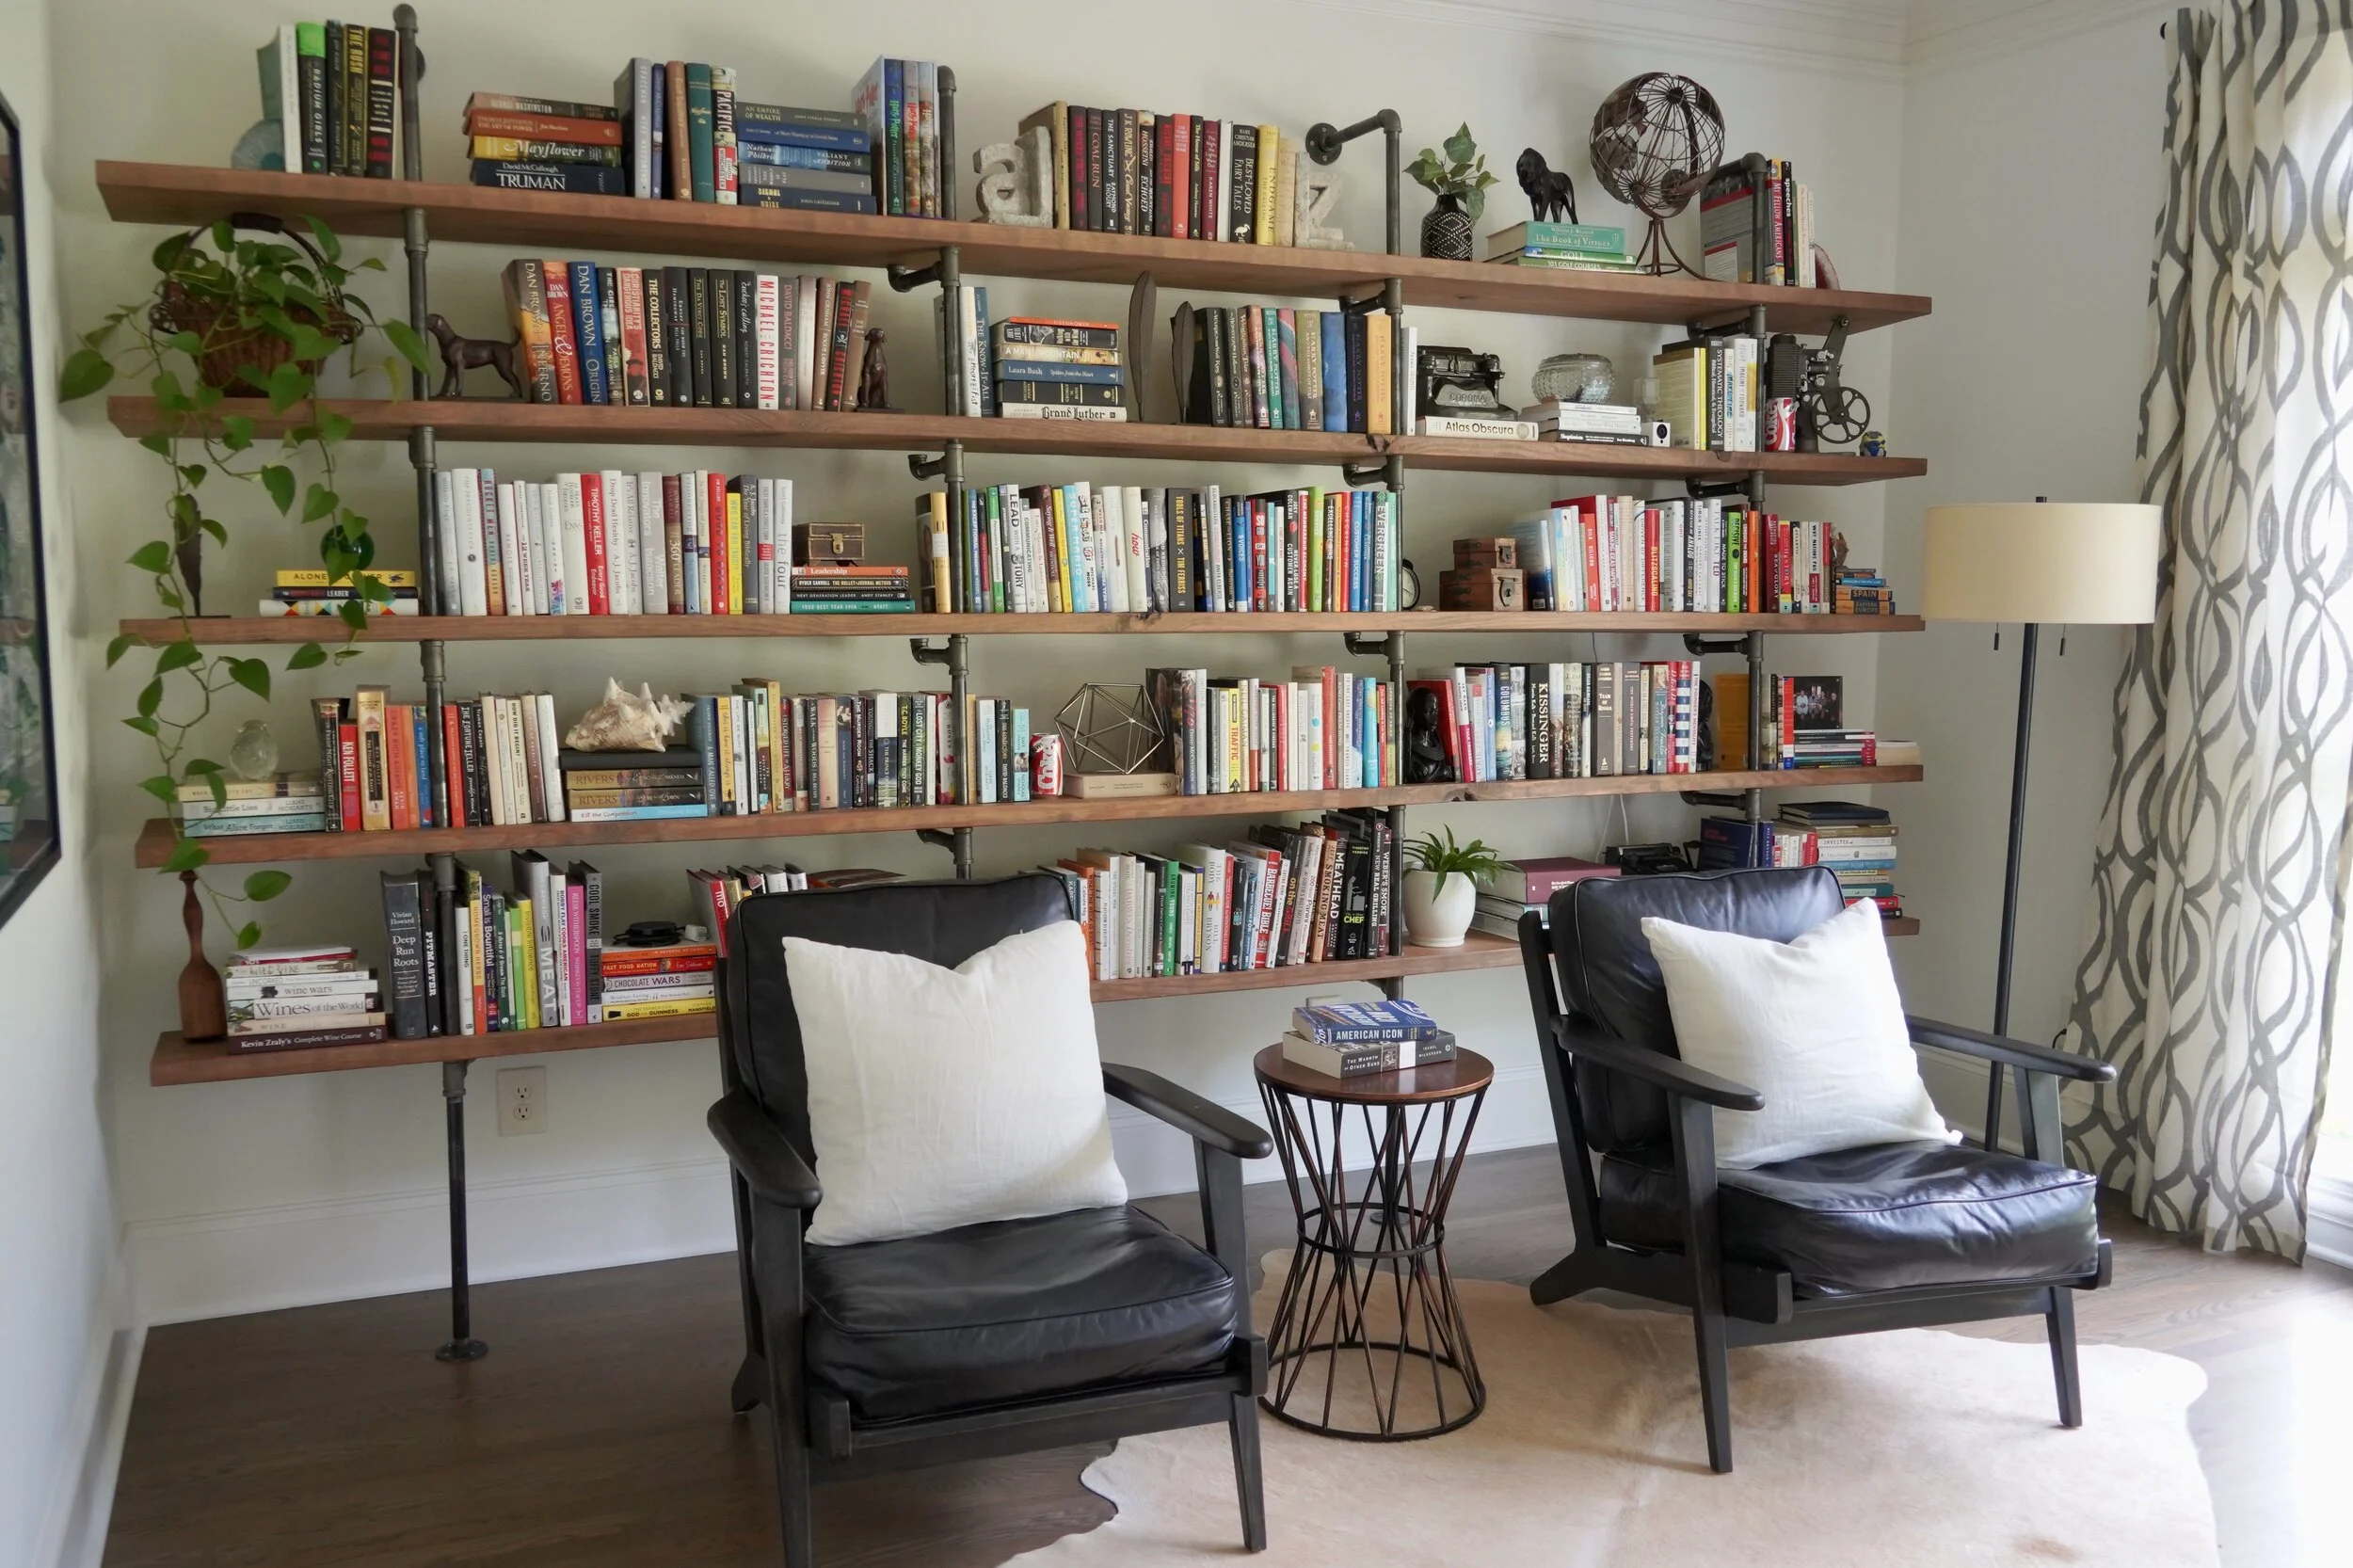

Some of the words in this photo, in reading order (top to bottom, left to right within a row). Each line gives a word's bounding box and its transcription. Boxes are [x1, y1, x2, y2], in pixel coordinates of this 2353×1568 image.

[313, 68, 324, 109] RADIUM
[716, 90, 733, 133] PACIFIC
[314, 112, 324, 143] GIRLS
[504, 140, 585, 159] Mayflower
[1092, 133, 1100, 162] COAL
[1107, 135, 1115, 178] SANCTUARY
[496, 173, 566, 191] TRUMAN
[1234, 159, 1243, 181] FAIRY
[1140, 175, 1148, 213] ECHOED
[1233, 184, 1242, 211] TALES
[1267, 167, 1277, 232] ENDGAME
[1784, 178, 1792, 217] speeches
[1773, 196, 1783, 222] FELLOW
[1535, 233, 1550, 242] The
[1552, 234, 1571, 243] Book
[1573, 236, 1581, 246] of
[1582, 237, 1610, 247] Virtues
[1774, 222, 1785, 259] AMERICANS
[577, 264, 591, 294] DAN
[1575, 263, 1601, 271] COURSES
[648, 279, 659, 296] THE
[784, 284, 793, 312] DAVID
[760, 280, 776, 332] MICHAEL
[580, 298, 596, 346] BROWN
[649, 296, 662, 349] COLLECTORS
[784, 312, 793, 350] BALDACCI
[977, 318, 985, 338] THE
[585, 359, 601, 403] ORIGIN
[607, 354, 616, 385] HAWKINS
[760, 342, 776, 401] CRICHTON
[978, 341, 990, 401] KNOW-IT-ALL
[1008, 366, 1026, 375] Laura
[1027, 367, 1043, 376] Bush
[1445, 422, 1470, 433] Atlas
[1471, 424, 1513, 436] Obscura
[590, 488, 600, 523] TIMOTHY
[1176, 495, 1185, 515] TOOLS
[1176, 515, 1185, 524] OF
[1731, 518, 1740, 546] DECISIVE
[593, 525, 602, 555] KELLER
[776, 533, 792, 554] the
[1024, 517, 1032, 573] COMMUNICATING
[1131, 533, 1143, 556] how
[1176, 524, 1185, 546] TITANS
[1376, 505, 1386, 574] EVERGREEN
[776, 561, 790, 590] four
[810, 568, 848, 576] Leadership
[1177, 556, 1186, 568] TIM
[1650, 546, 1658, 597] BLITZSCALING
[1721, 562, 1726, 570] TO
[1177, 569, 1187, 594] FERRISS
[809, 706, 818, 728] WALK
[1500, 686, 1511, 726] COLUMBUS
[1539, 682, 1549, 764] KISSINGER
[343, 741, 355, 755] KEN
[1231, 726, 1240, 760] TRAFFIC
[343, 756, 356, 783] FOLLETT
[915, 746, 923, 772] MONKEY
[576, 773, 615, 785] RIVERS
[708, 766, 716, 788] CALLED
[579, 794, 617, 806] RIVERS
[709, 789, 717, 801] OVE
[1381, 851, 1390, 887] WEBER'S
[1262, 867, 1277, 910] BARBECUE!
[1321, 863, 1334, 911] SMOKING
[1329, 852, 1346, 920] MEATHEAD
[483, 893, 492, 917] Small
[571, 892, 581, 912] REESE
[1380, 888, 1388, 917] SMOKE
[472, 905, 482, 954] HOMEGROWN
[571, 912, 582, 953] WITHERSPOON
[1258, 911, 1273, 934] BIBLE
[1317, 913, 1327, 939] MEAT
[1343, 916, 1365, 924] CHEF
[392, 936, 417, 946] Deep
[485, 925, 495, 967] Bountiful
[1205, 917, 1213, 952] BRYSON
[392, 958, 420, 968] Roots
[395, 947, 415, 956] Run
[425, 931, 437, 997] PITMASTER
[284, 986, 308, 995] wine
[309, 984, 332, 994] wars
[539, 947, 557, 1012] MEAT
[614, 978, 649, 988] CHOCOLATE
[651, 975, 680, 985] WARS
[256, 1001, 312, 1016] Wines
[337, 1000, 363, 1010] World
[265, 1038, 292, 1048] Zraly's
[294, 1035, 323, 1045] Complete
[1336, 1029, 1379, 1041] AMERICAN
[1383, 1029, 1402, 1038] ICON
